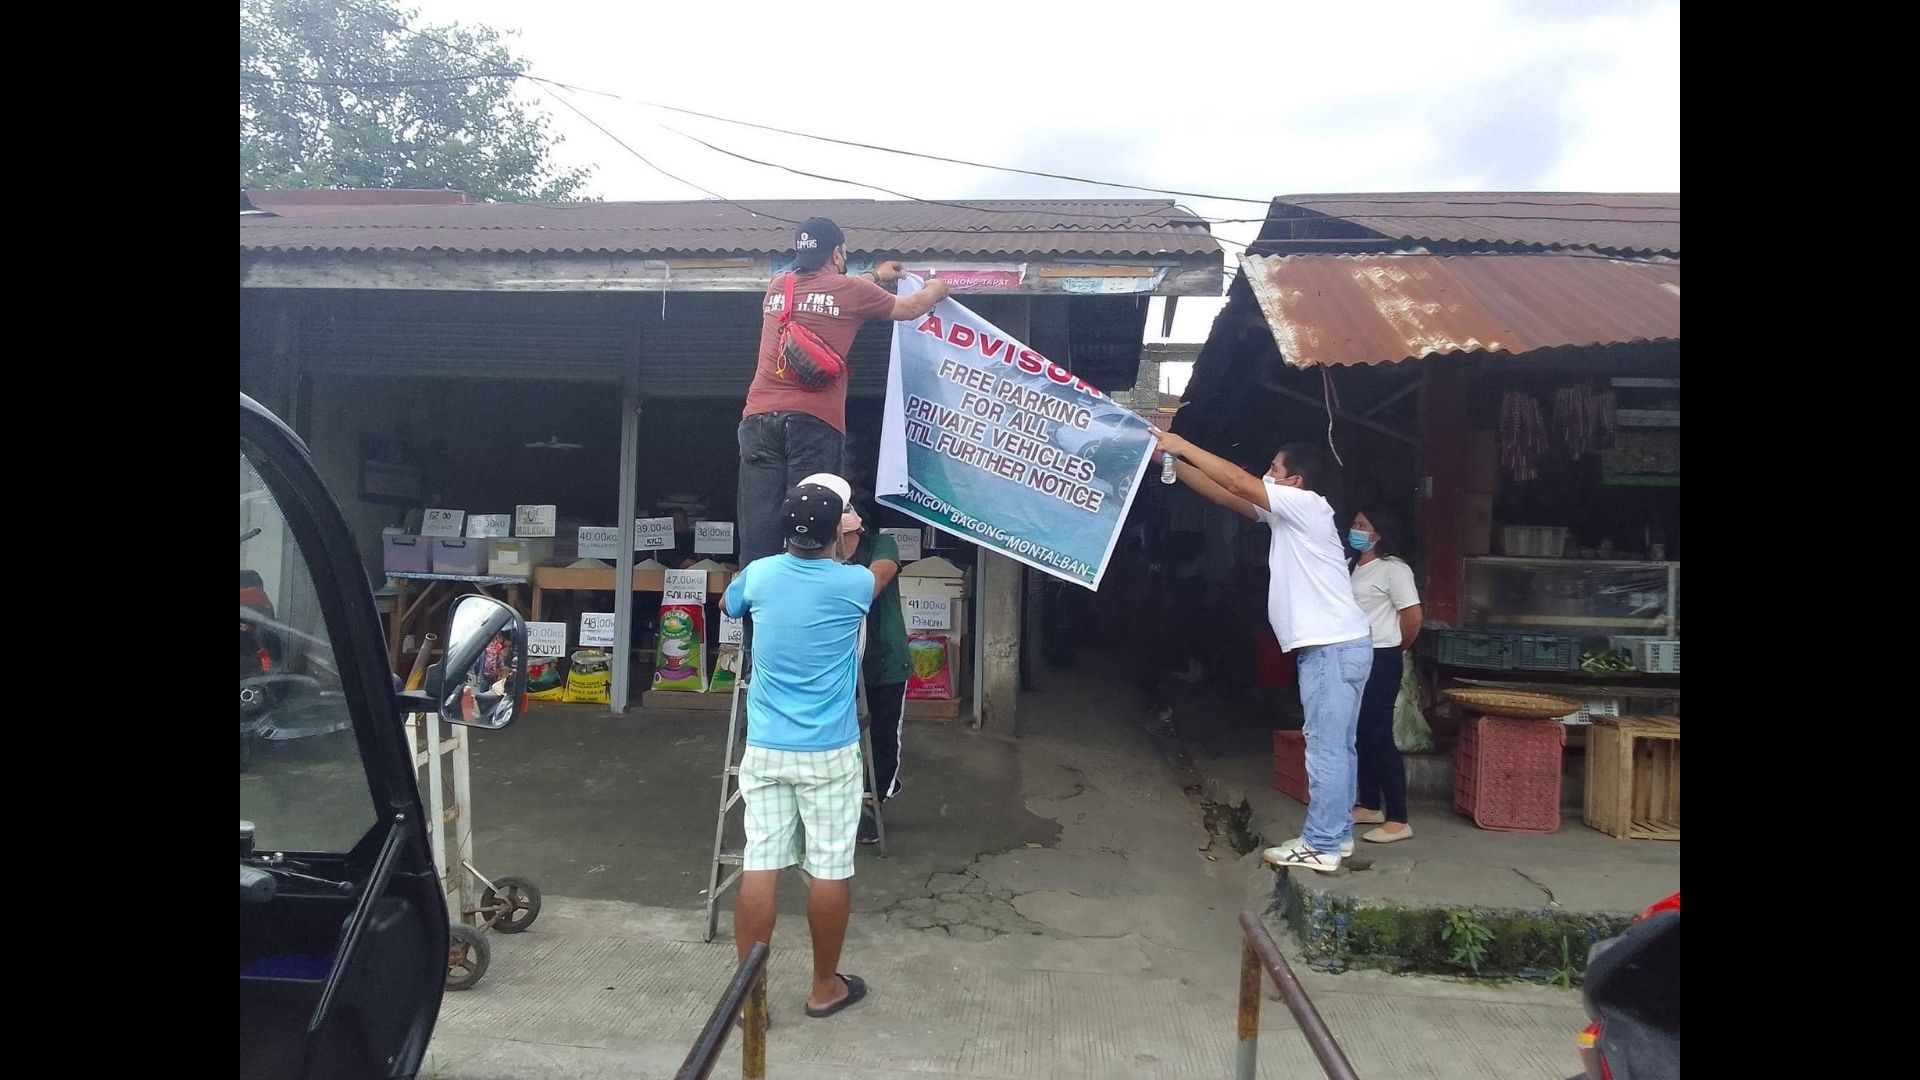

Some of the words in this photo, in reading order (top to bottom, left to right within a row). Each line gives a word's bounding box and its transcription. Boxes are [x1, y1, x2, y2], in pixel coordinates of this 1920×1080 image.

[806, 293, 835, 306] FMS
[938, 358, 995, 394] FREE
[996, 380, 1092, 431] PARKING
[961, 392, 1005, 423] FOR
[1008, 409, 1050, 442] ALL
[905, 395, 987, 442] PRIVATE
[992, 427, 1095, 482] VEHICLES
[936, 432, 1026, 483] FURTHER
[1027, 467, 1104, 512] NOTICE
[579, 532, 618, 542] 40.00KG
[636, 523, 673, 533] 39.00KG
[950, 511, 1006, 541] BAGONG
[1005, 535, 1090, 577] MONTALBAN
[666, 575, 703, 585] 47.00KG
[908, 600, 946, 610] 41.00KG
